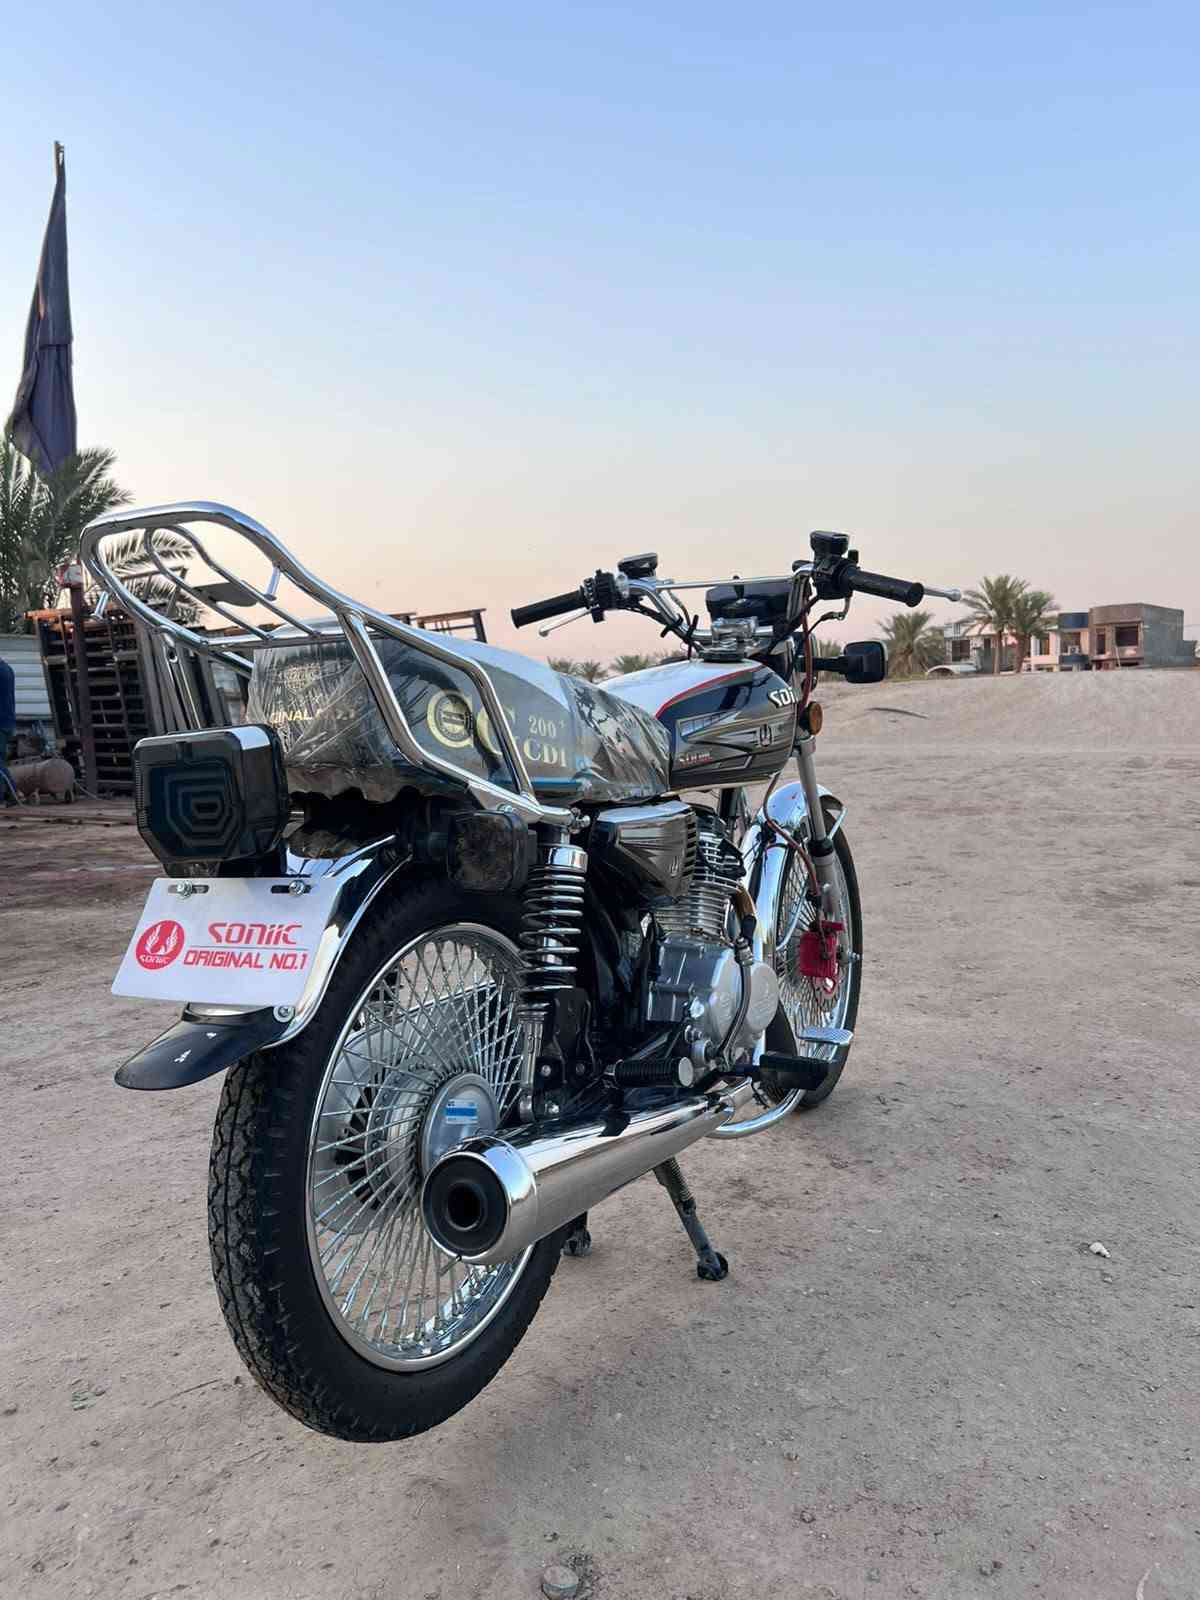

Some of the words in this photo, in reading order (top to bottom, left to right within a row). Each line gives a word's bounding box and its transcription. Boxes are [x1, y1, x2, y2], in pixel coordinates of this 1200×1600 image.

[523, 737, 567, 767] CDI
[183, 951, 263, 969] ORIGINAL
[268, 953, 307, 970] NO.1
